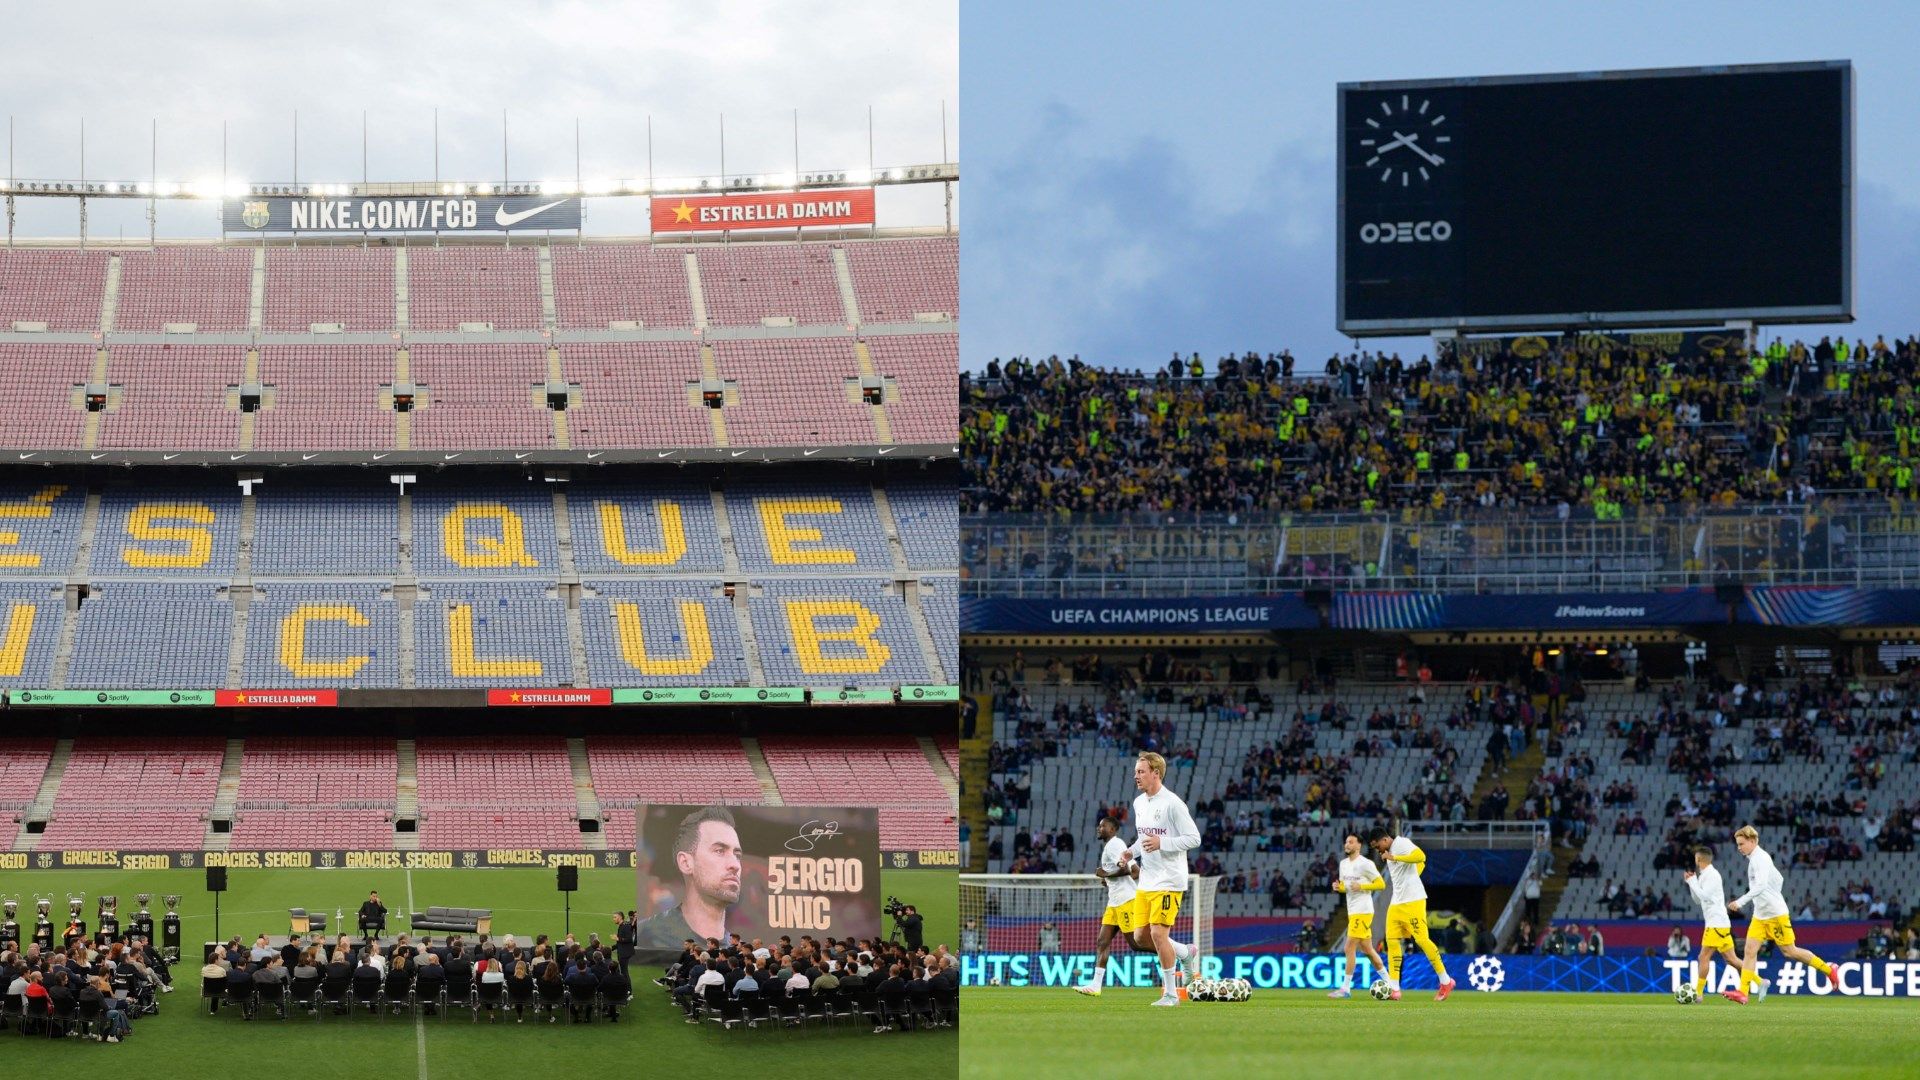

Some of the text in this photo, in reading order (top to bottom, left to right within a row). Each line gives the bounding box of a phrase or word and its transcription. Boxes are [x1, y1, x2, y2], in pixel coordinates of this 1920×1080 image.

[291, 200, 477, 229] NIKE.COM/FCB
[700, 201, 851, 222] ESTRELLA DAMM
[443, 497, 857, 568] QUE
[1051, 607, 1269, 623] UEFA CHAMPIONS LEAGUE
[280, 600, 891, 678] CLUB
[33, 693, 54, 702] Spotify
[109, 693, 130, 702] Spotify
[181, 693, 203, 702] Spotify
[248, 695, 316, 703] ESTRELLA DAMM
[522, 694, 591, 703] ESTRELLA DAMM
[654, 691, 676, 700] Spotify
[711, 691, 733, 700] Spotify
[769, 691, 791, 700] Spotify
[925, 689, 948, 698] Spotify
[122, 854, 170, 870] SERGIO
[264, 852, 312, 868] SERGIO
[405, 852, 453, 868] SERGIO
[547, 853, 595, 869] SERGIO
[768, 886, 831, 931] ÚNIC
[1162, 894, 1171, 911] 10
[1773, 926, 1784, 939] 24
[961, 955, 1029, 987] HTS
[1039, 955, 1097, 987] WE
